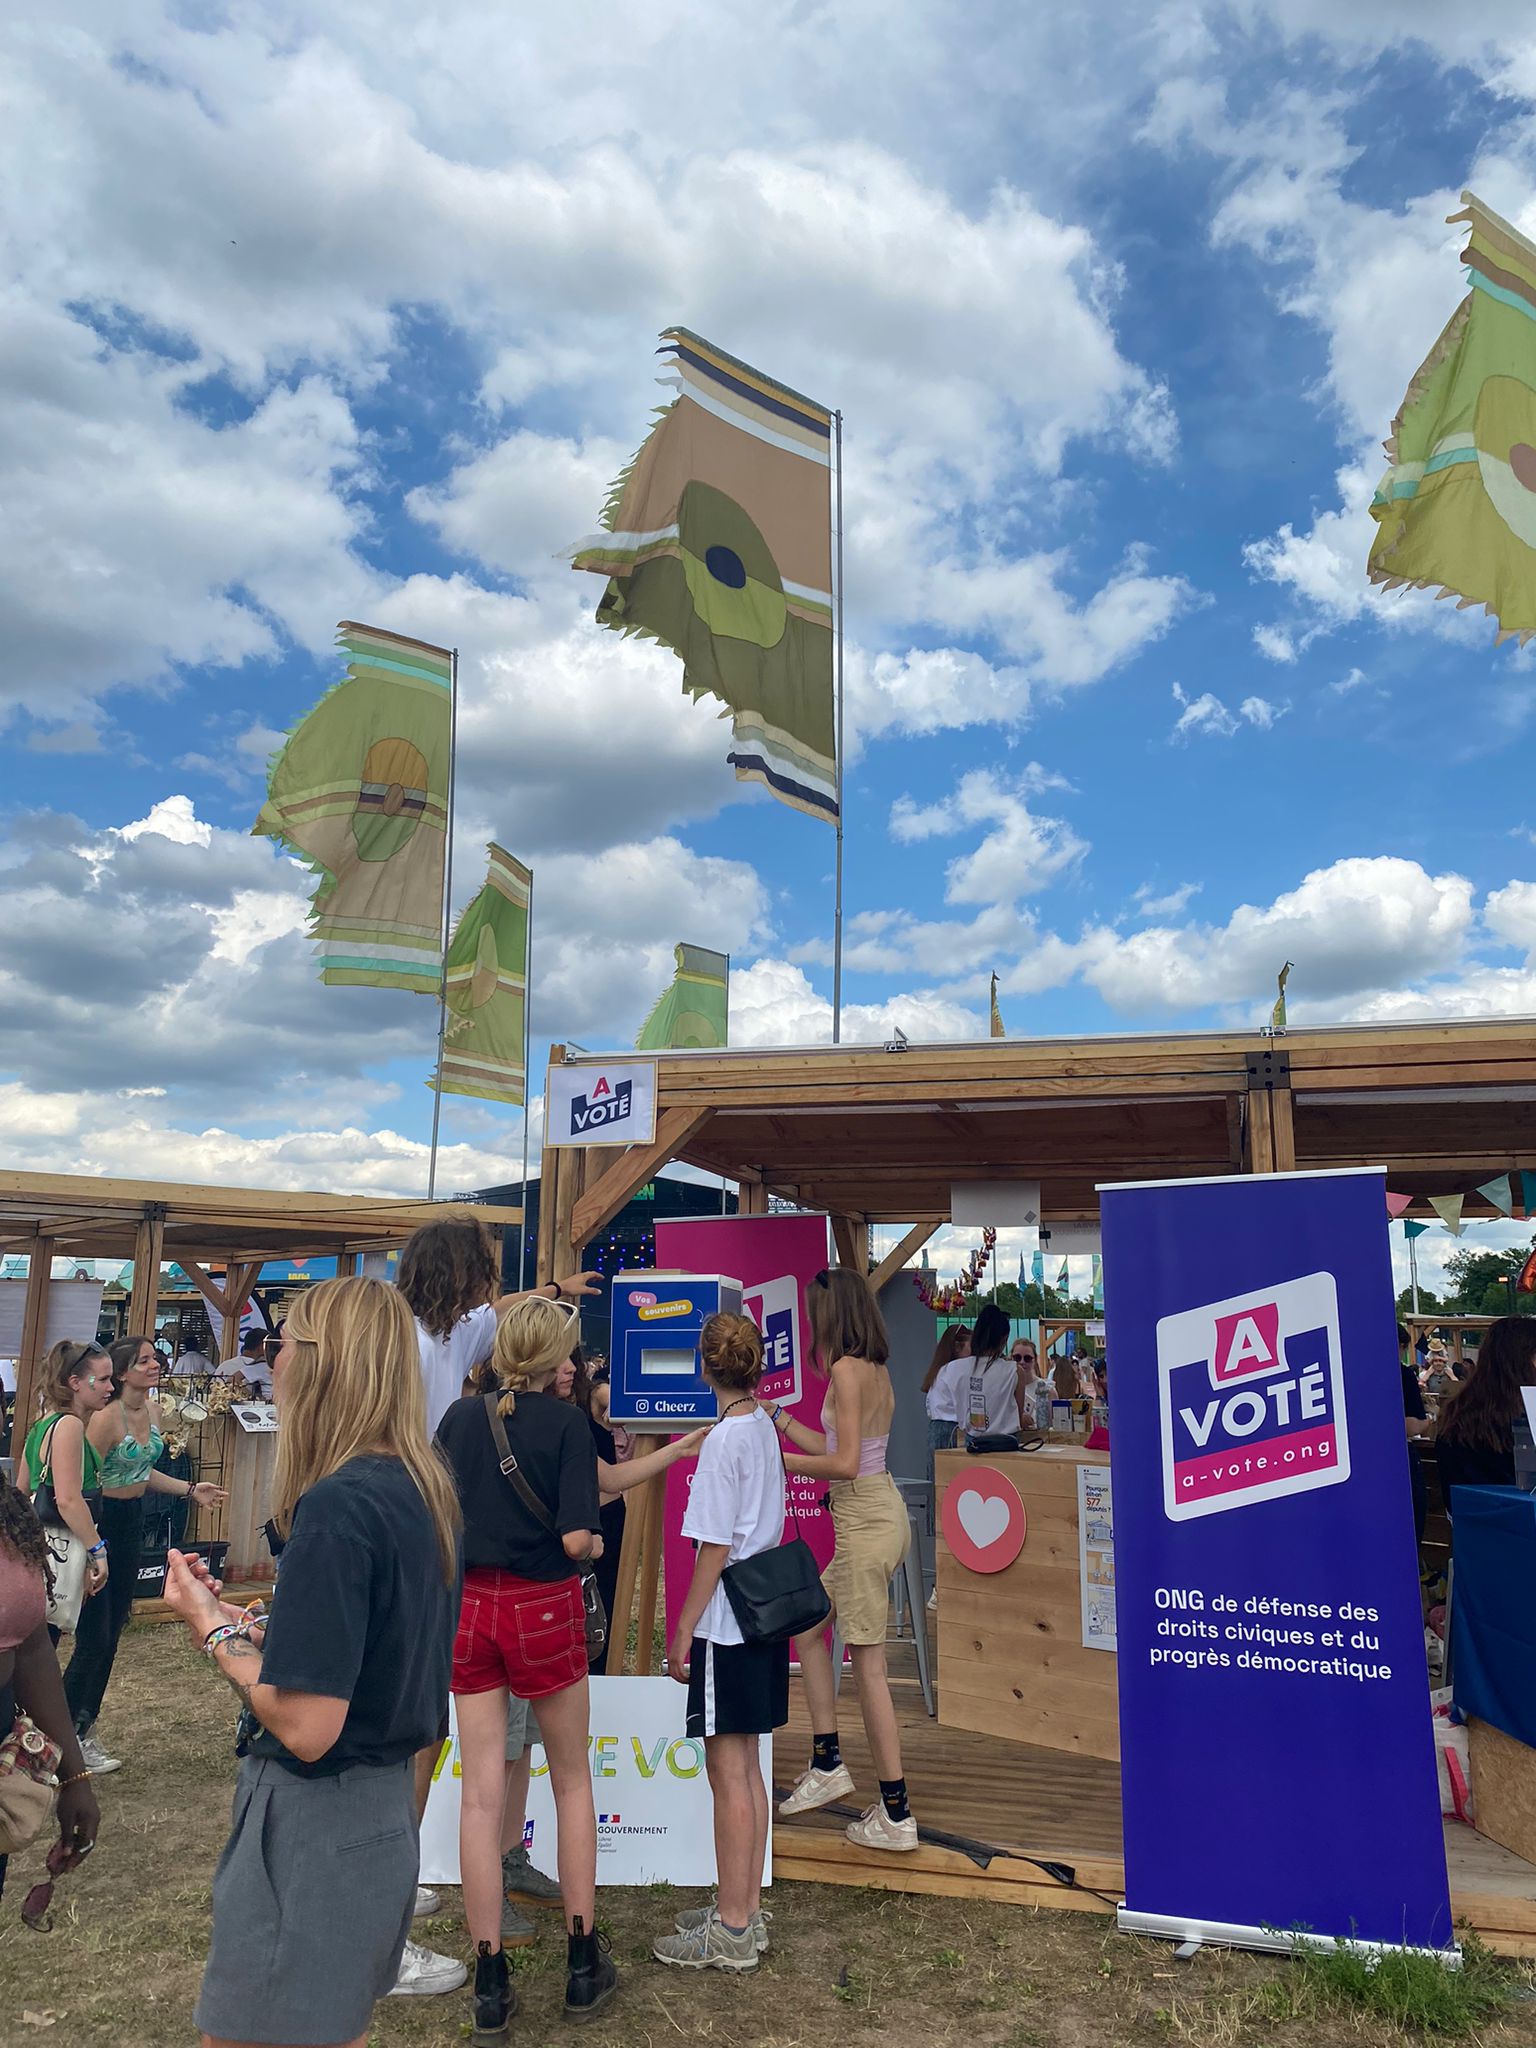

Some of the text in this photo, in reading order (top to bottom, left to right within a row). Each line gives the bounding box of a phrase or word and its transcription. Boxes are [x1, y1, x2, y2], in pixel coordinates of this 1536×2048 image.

[592, 1076, 610, 1099] A
[573, 1093, 629, 1129] VOTÉ
[635, 1295, 651, 1304] Vos
[644, 1303, 687, 1316] souvenirs
[1223, 1316, 1273, 1373] A
[655, 1400, 697, 1412] Cheerz
[1178, 1362, 1327, 1448] VOTÉ
[1182, 1439, 1330, 1488] a-vote.ong
[793, 1475, 816, 1485] des
[785, 1490, 815, 1501] et du
[1086, 1498, 1101, 1507] 577
[1154, 1588, 1379, 1622] ONG de défense des
[1157, 1618, 1380, 1650] droits civiques et du
[1149, 1647, 1393, 1682] progrès démocratique
[597, 1826, 668, 1834] GOUVERNEMENT
